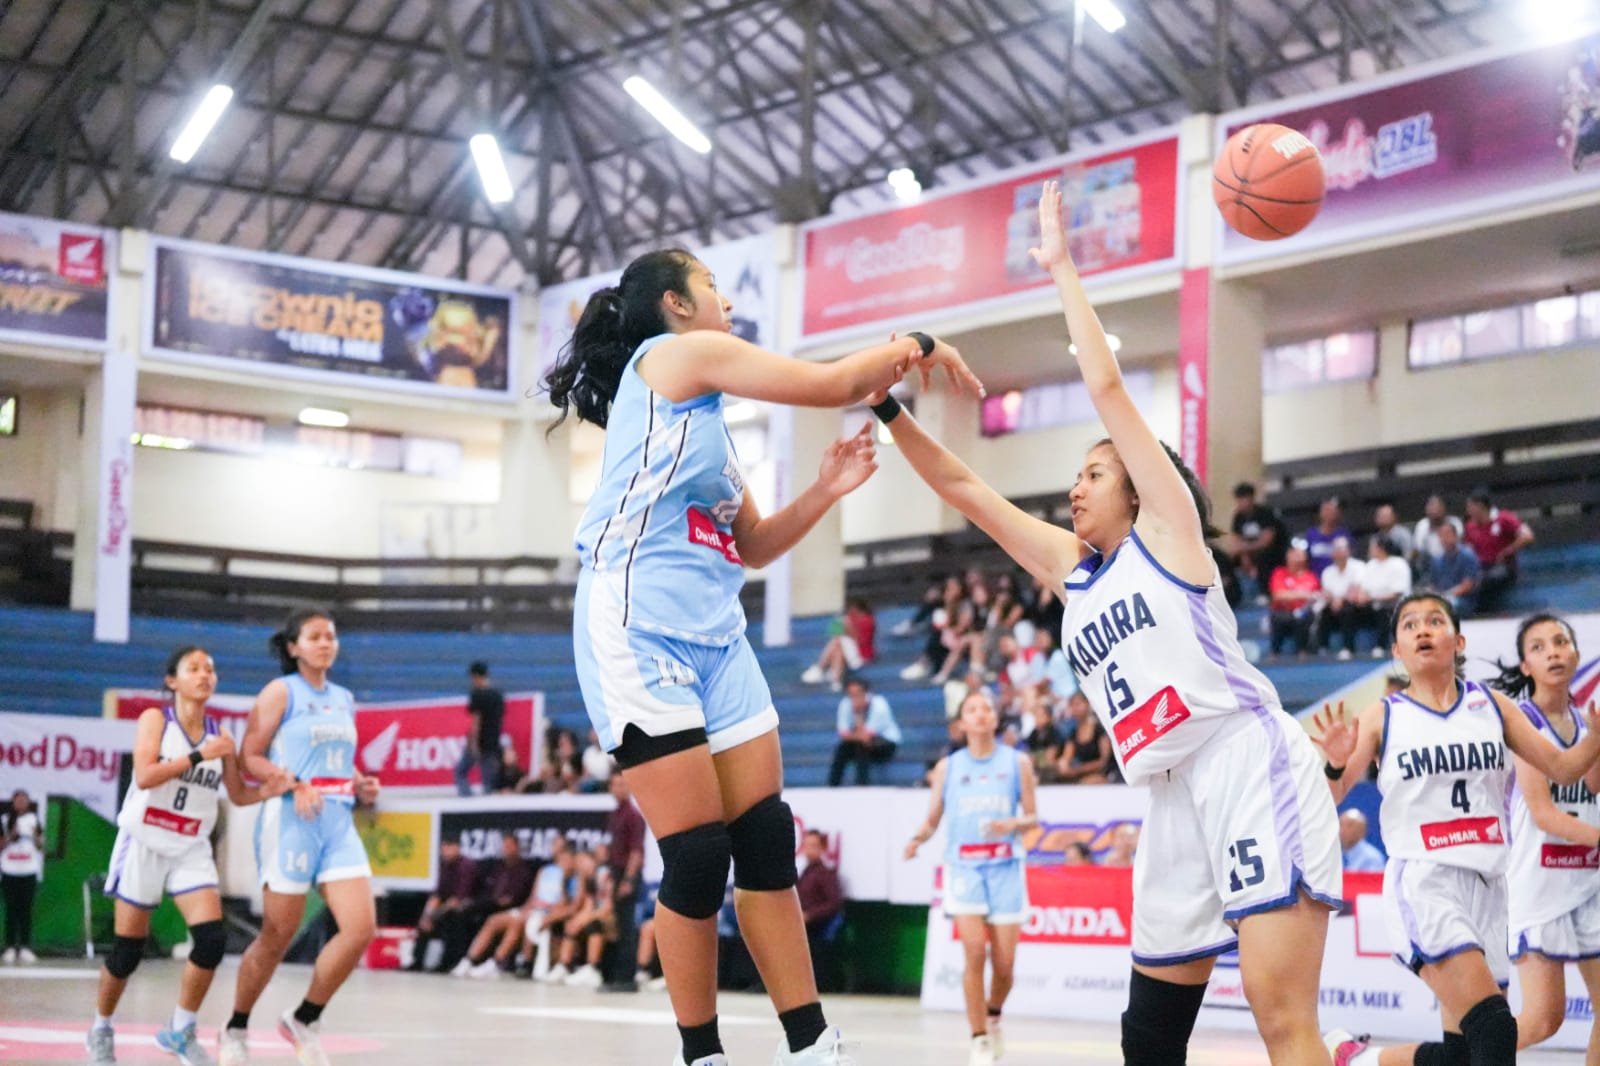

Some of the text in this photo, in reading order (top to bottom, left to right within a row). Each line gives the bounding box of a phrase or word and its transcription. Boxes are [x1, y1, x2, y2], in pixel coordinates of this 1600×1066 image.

[1067, 592, 1157, 678] MADARA
[1103, 661, 1135, 720] 15
[396, 736, 468, 771] HON
[1397, 741, 1504, 781] SMADARA
[173, 786, 189, 812] 8
[1451, 779, 1471, 814] 4
[285, 851, 309, 874] 14
[1228, 838, 1266, 893] 15
[1020, 905, 1127, 938] ONDA
